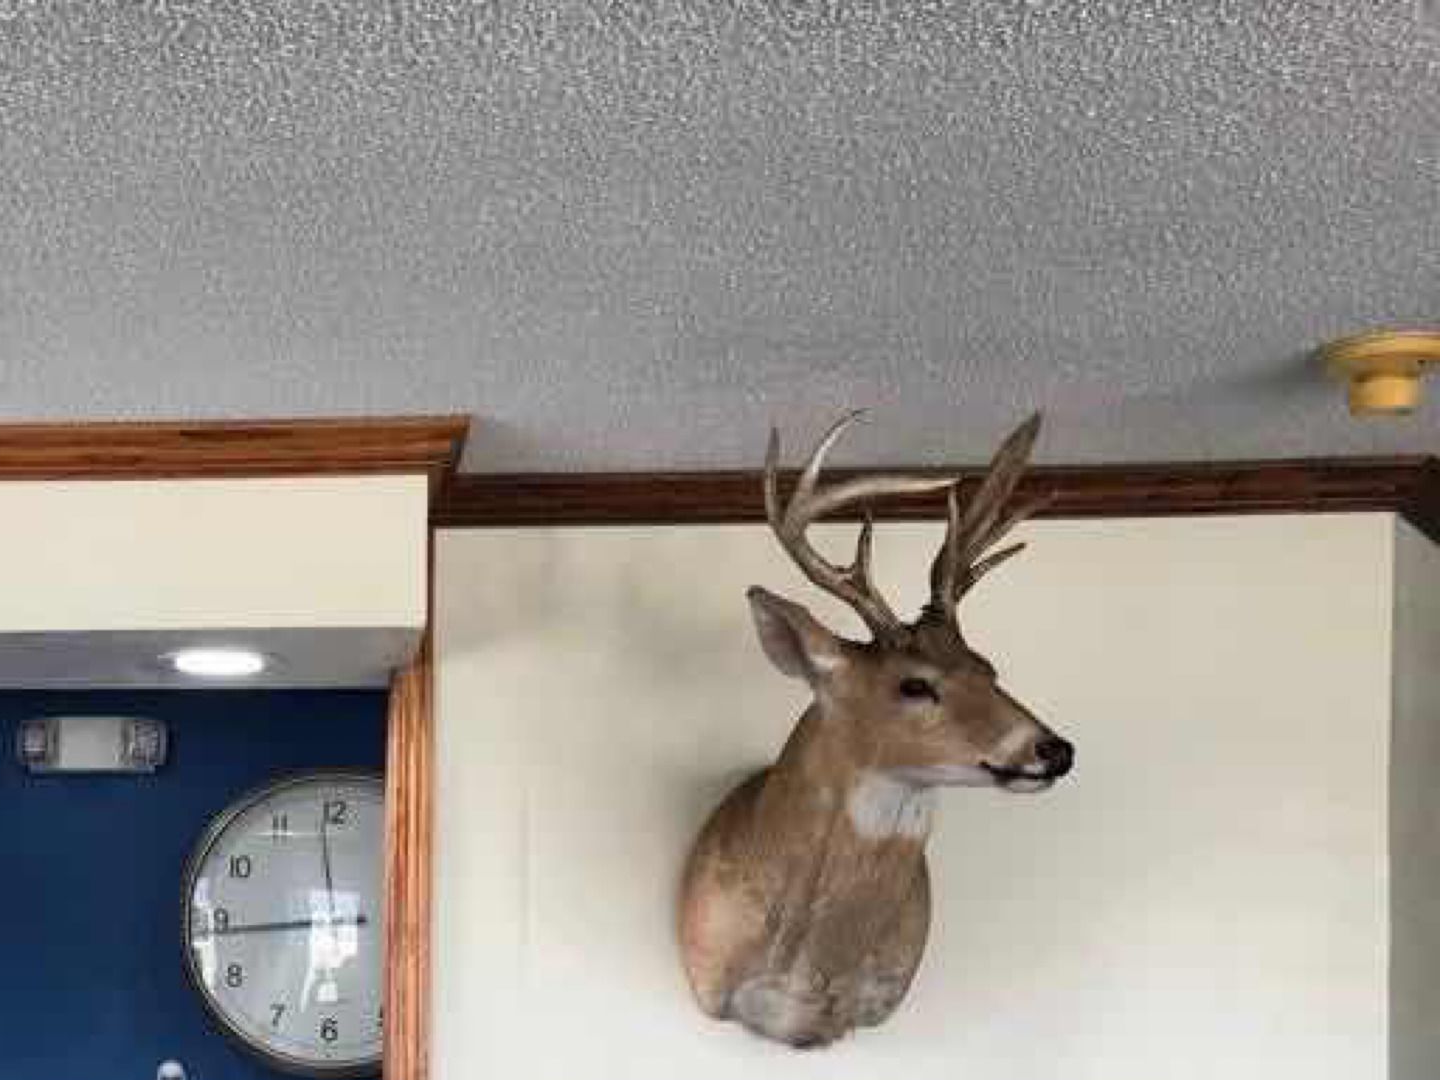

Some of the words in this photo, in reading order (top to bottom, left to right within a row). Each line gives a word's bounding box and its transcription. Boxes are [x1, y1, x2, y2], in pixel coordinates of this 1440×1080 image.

[322, 800, 347, 825] 12
[271, 812, 289, 841] 11
[228, 854, 252, 879] 10
[213, 907, 229, 934] 9
[227, 964, 243, 988] 8
[269, 1003, 286, 1028] 7
[320, 1017, 339, 1041] 6
